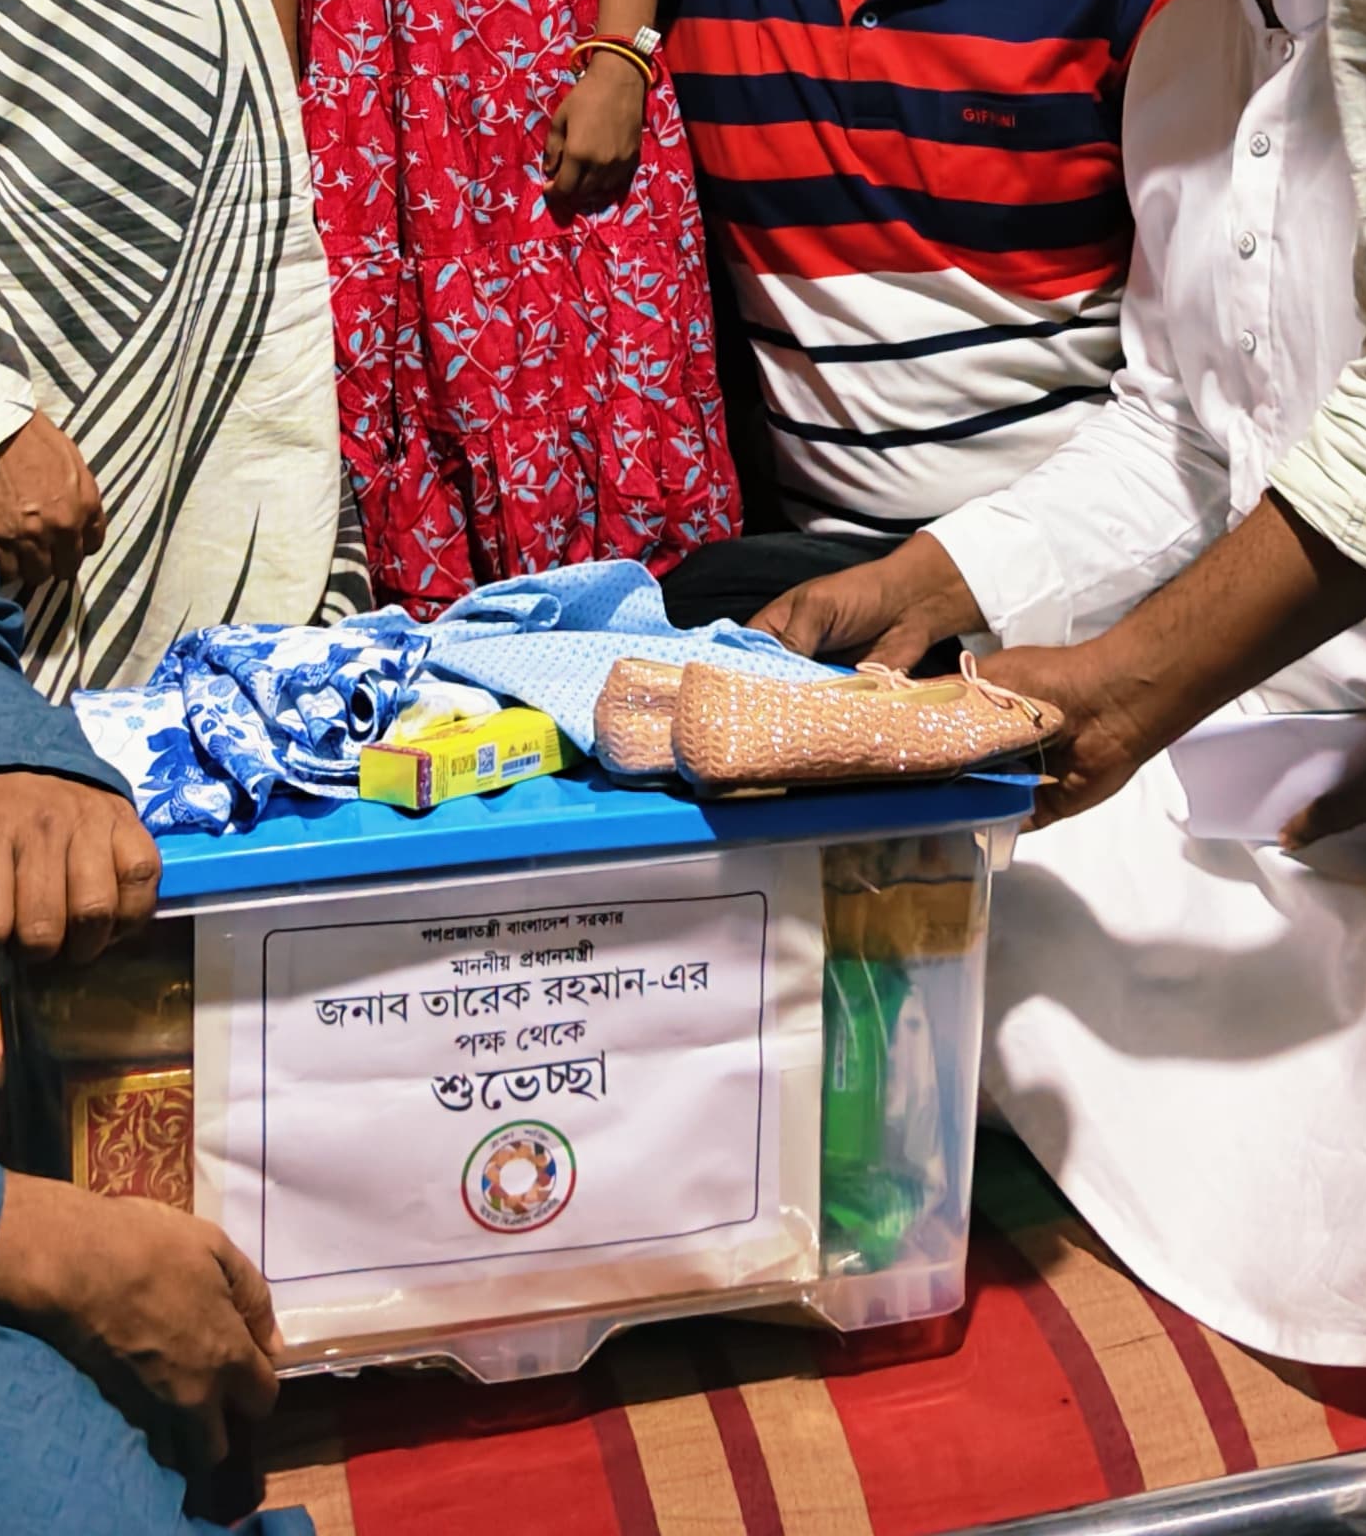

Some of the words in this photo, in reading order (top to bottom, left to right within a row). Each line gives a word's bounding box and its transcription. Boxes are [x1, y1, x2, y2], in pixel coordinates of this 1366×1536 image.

[507, 916, 569, 936] বাংলাদেশ
[576, 911, 624, 928] সরকার
[451, 951, 510, 976] মাননীয়
[519, 939, 594, 968] প্রধানমন্ত্রী
[314, 992, 410, 1027] জনাব
[420, 982, 532, 1018] তারেক
[542, 962, 710, 1006] রহমান-এর
[454, 1030, 507, 1057] পক্ষ
[516, 1020, 586, 1052] থেকে
[431, 1051, 607, 1112] শুভেচ্ছা
